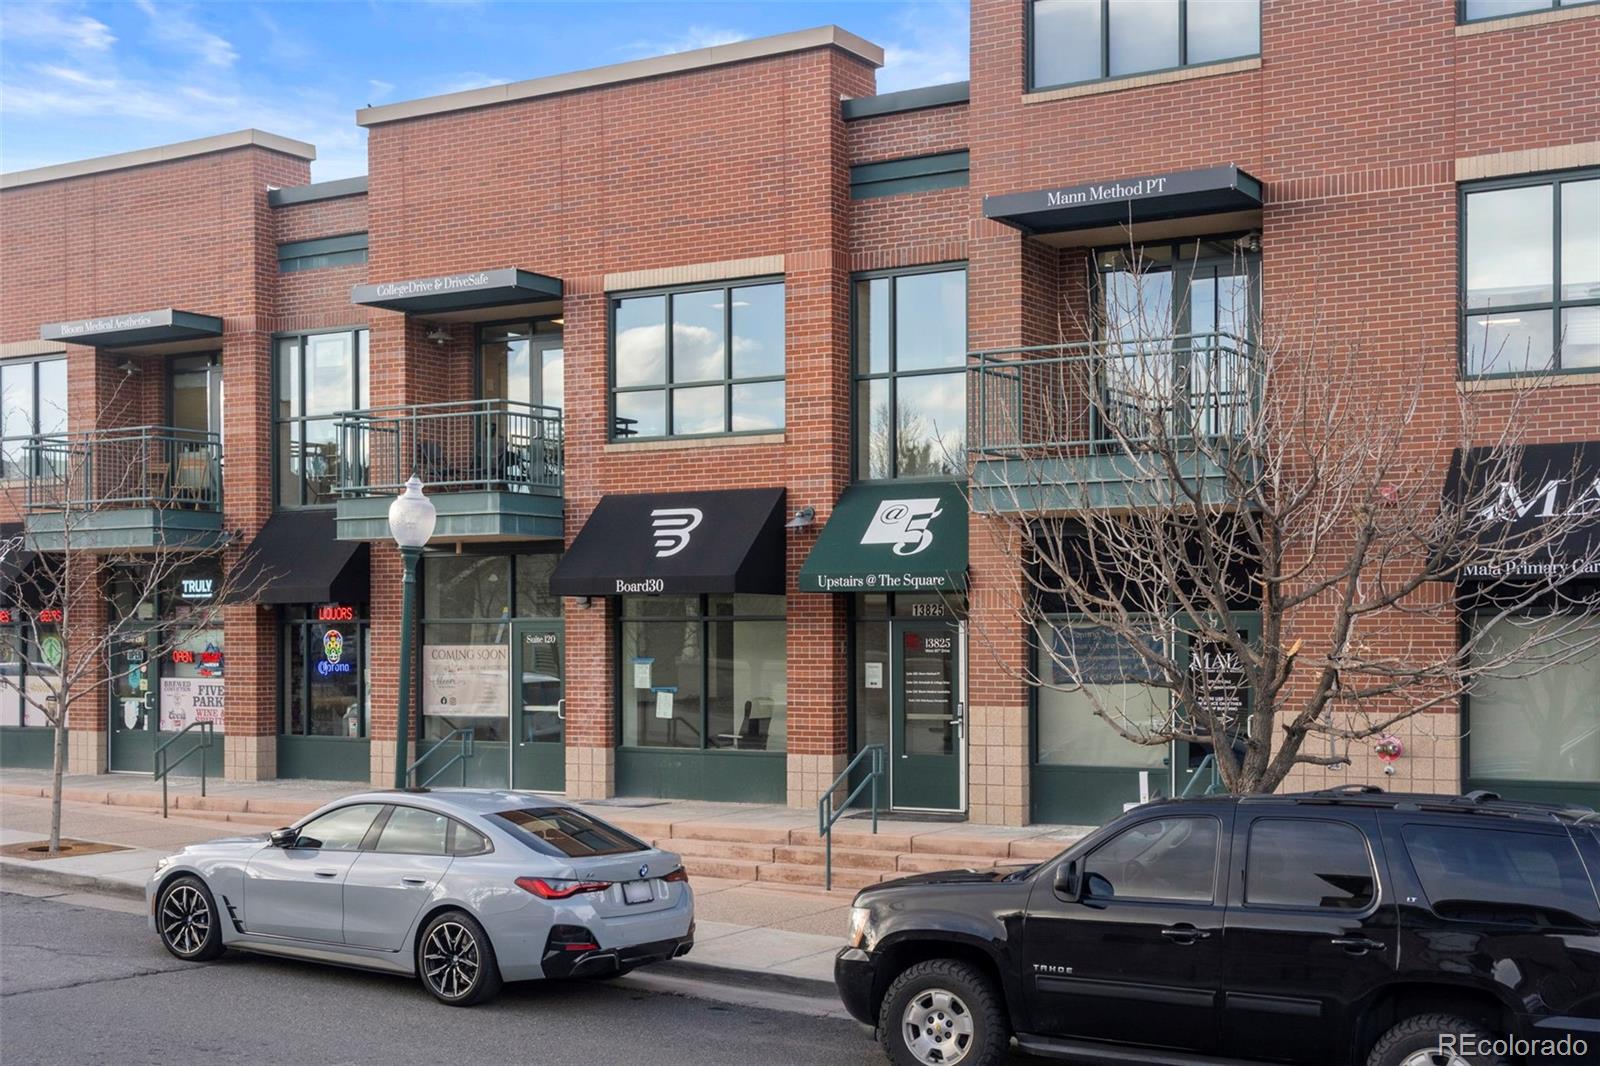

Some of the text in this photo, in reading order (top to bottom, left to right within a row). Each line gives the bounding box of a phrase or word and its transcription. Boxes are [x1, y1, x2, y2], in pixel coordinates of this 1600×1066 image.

[1047, 177, 1167, 206] Mann Method PT
[376, 273, 489, 297] CollegeDrive & DriveSafe
[85, 319, 113, 333] Medical
[114, 314, 152, 329] Aesthetics
[1505, 560, 1567, 579] Primary
[182, 580, 213, 592] TRULY
[615, 579, 664, 593] Board30
[817, 573, 945, 590] Upstairs @ The Square
[914, 603, 944, 616] 13825
[526, 634, 556, 644] Suite 120
[925, 637, 951, 649] 13825
[172, 650, 194, 663] OPEN
[432, 648, 507, 660] COMING SOON
[318, 661, 350, 676] Corona
[198, 685, 225, 696] FIVE
[192, 696, 224, 707] PARK
[195, 709, 218, 717] WINE
[195, 717, 225, 725] SPIRIT
[1033, 964, 1073, 975] TAHOE
